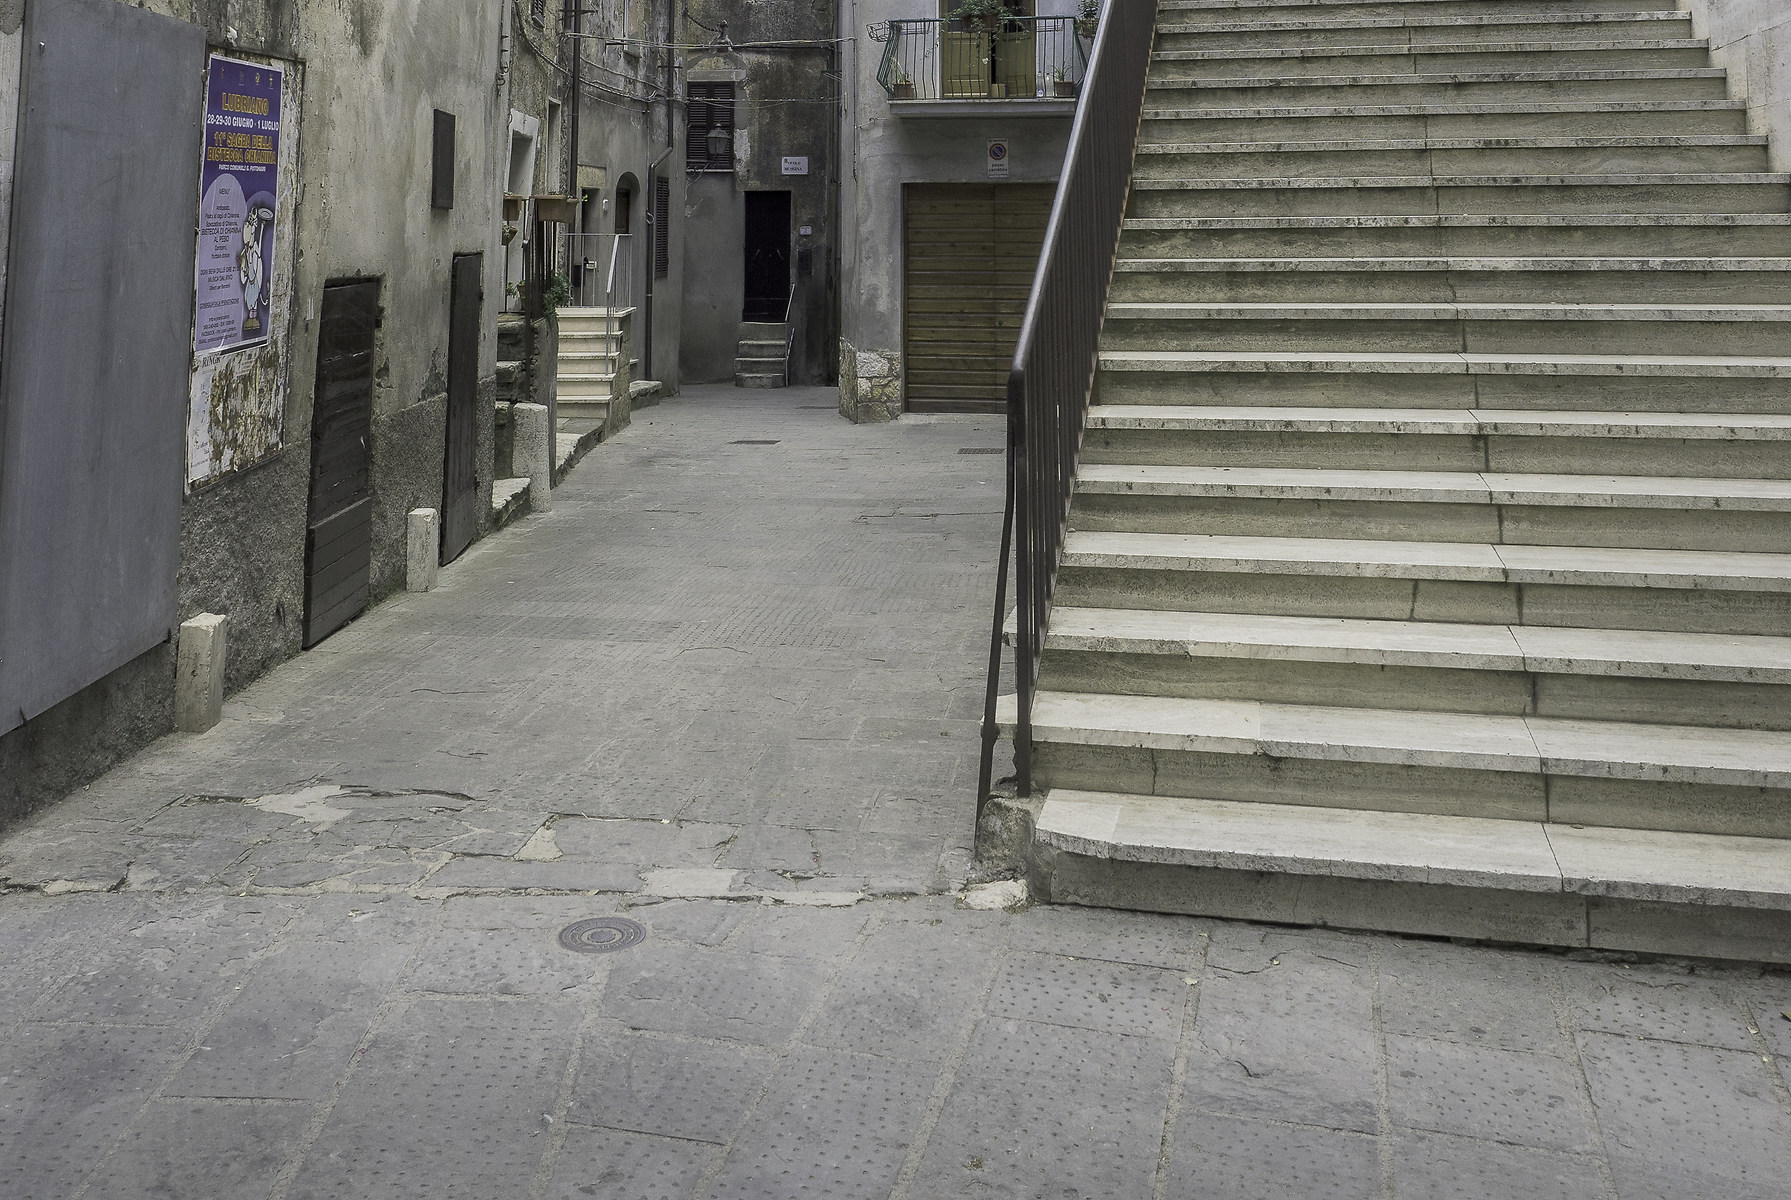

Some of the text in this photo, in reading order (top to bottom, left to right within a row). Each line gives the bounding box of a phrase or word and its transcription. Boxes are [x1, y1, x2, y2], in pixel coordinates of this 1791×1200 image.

[222, 92, 268, 116] LUBRIANO
[207, 114, 232, 126] 28-29-30
[232, 116, 254, 128] GIUGNO
[262, 120, 279, 131] LUGLIO
[226, 132, 250, 148] SAGRA
[252, 134, 272, 150] DELLA
[207, 146, 276, 164] BISTECCA CHIANINA
